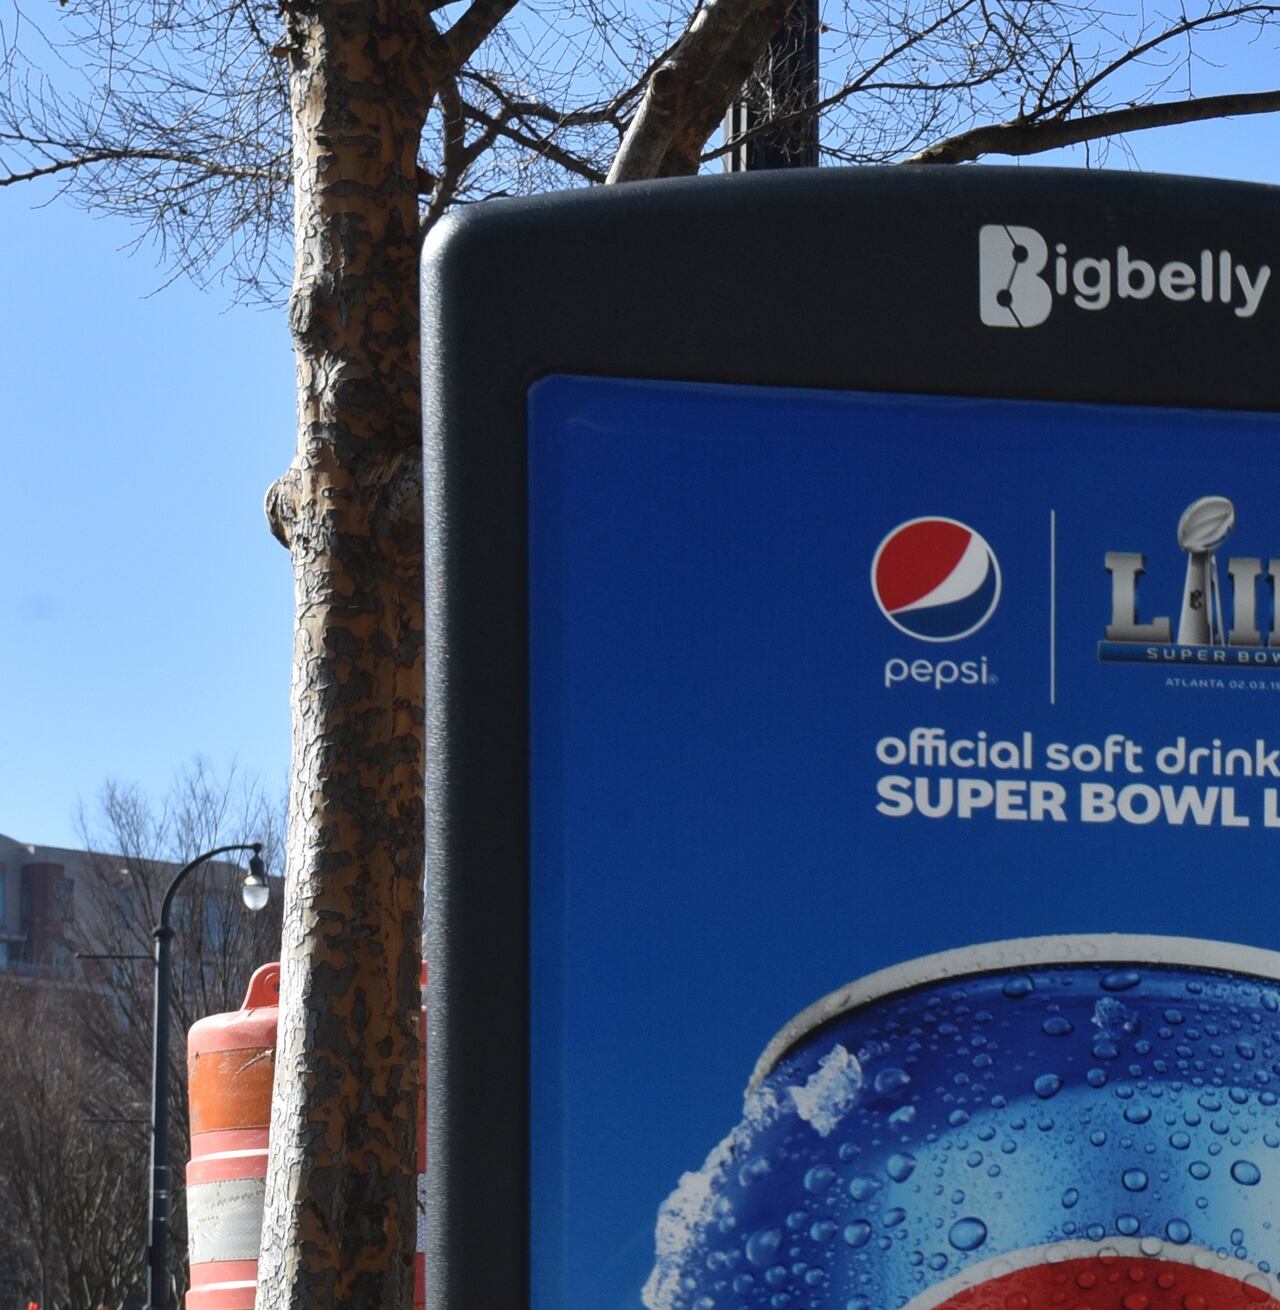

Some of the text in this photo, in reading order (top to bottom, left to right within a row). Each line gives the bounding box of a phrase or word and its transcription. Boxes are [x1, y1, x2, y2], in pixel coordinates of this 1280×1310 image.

[979, 224, 1271, 328] Bigbelly
[884, 656, 990, 690] pepsi
[1147, 648, 1226, 663] SUPER
[1165, 677, 1225, 689] ATLANTA
[876, 727, 1033, 769] official
[1045, 735, 1143, 773] soft
[875, 775, 1067, 822] SUPER
[1080, 782, 1250, 827] BOWL
